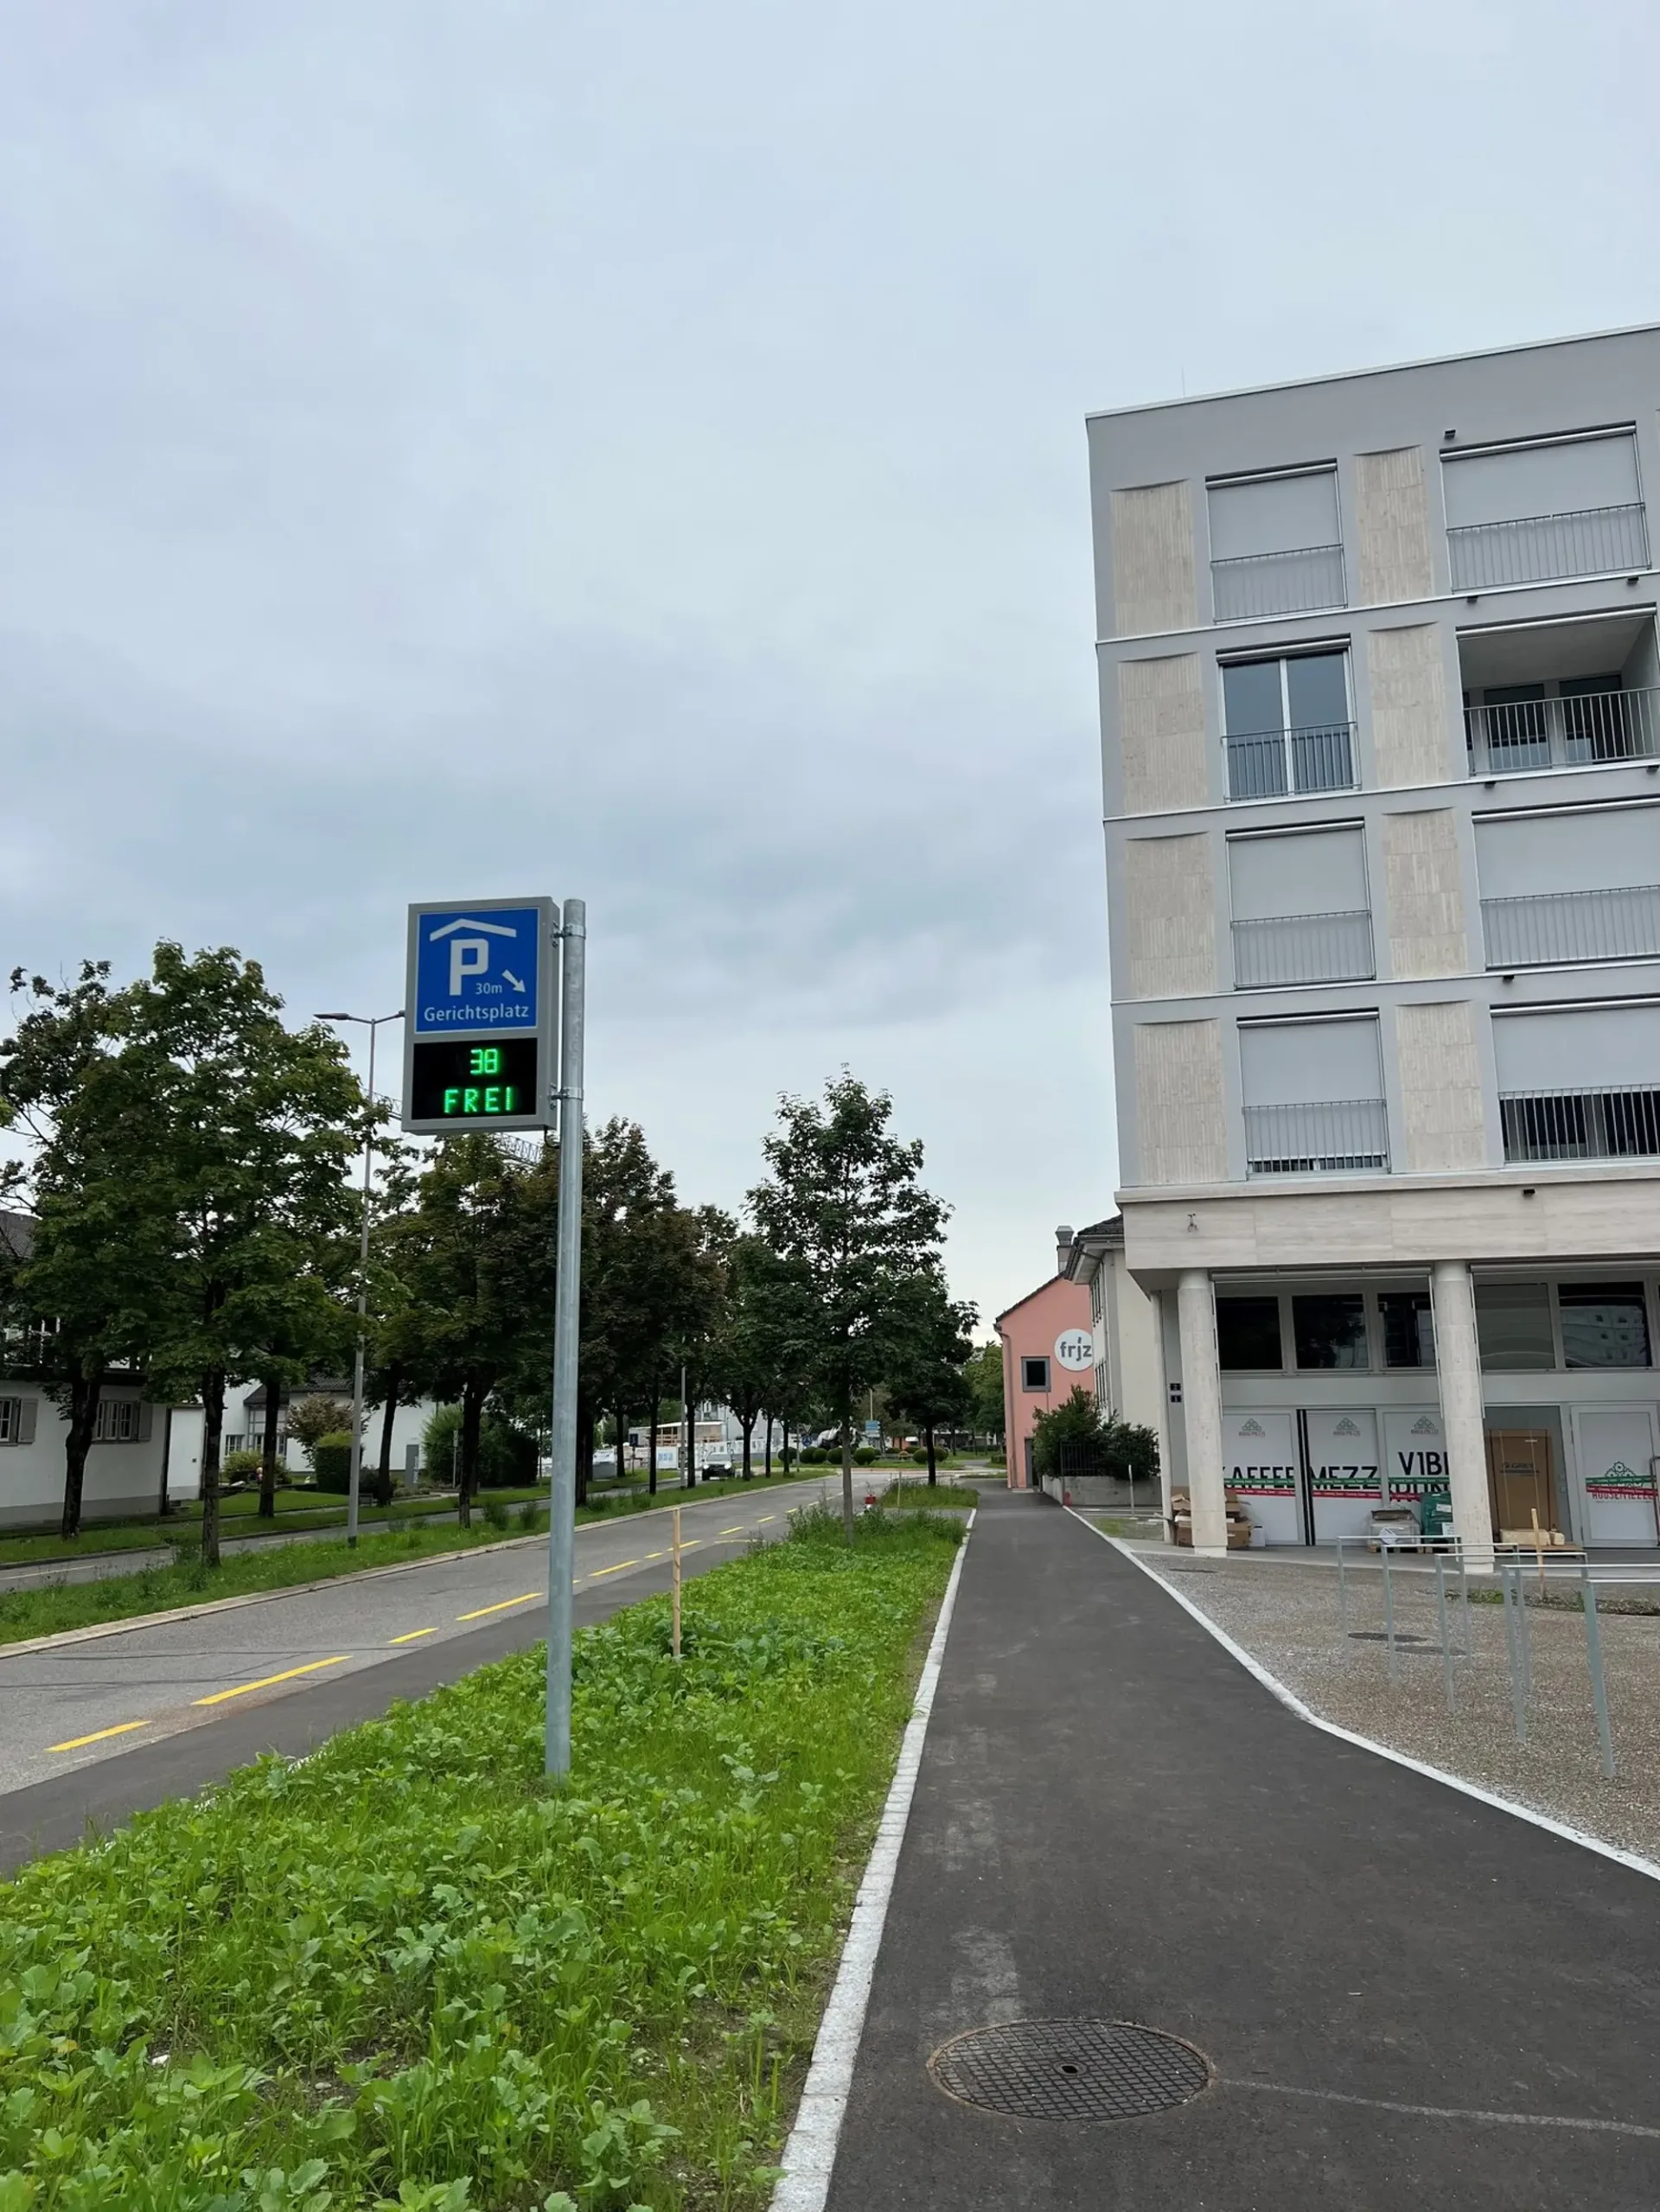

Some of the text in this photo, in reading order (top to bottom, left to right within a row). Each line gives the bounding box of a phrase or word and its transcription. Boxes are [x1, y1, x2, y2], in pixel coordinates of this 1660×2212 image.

[449, 938, 489, 997] P
[475, 982, 503, 995] 30m
[424, 1003, 529, 1022] Gerichtsplatz
[469, 1048, 499, 1074] 38
[444, 1087, 514, 1114] FREI
[1223, 1466, 1294, 1488] AFFEE
